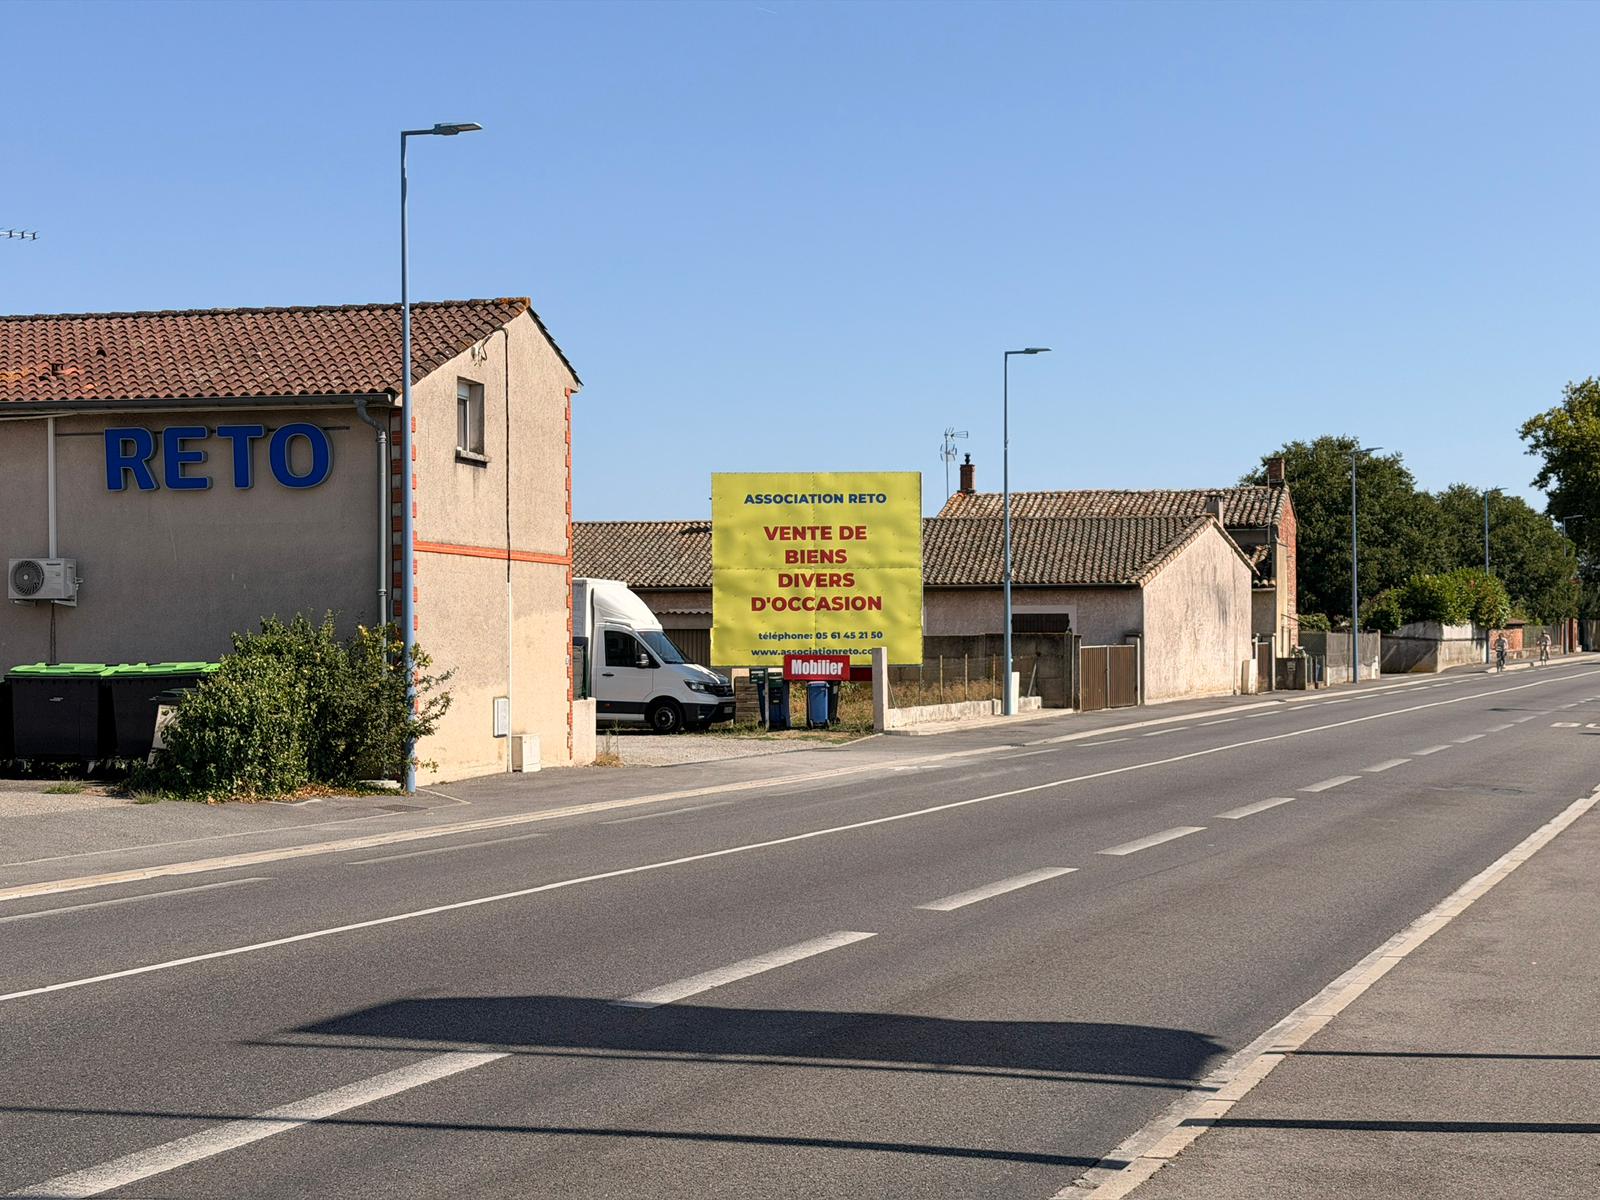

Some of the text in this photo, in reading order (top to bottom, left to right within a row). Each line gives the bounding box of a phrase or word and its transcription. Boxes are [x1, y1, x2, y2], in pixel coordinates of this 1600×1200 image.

[104, 422, 334, 492] RETO
[744, 493, 887, 504] ASSOCIATION RETO
[764, 525, 867, 541] VENTE DE
[785, 549, 848, 564] BIENS
[778, 572, 855, 588] DIVERS
[751, 596, 882, 612] D'OCCASION
[758, 631, 883, 641] téléphone: 05 61 45 21 50
[751, 647, 873, 656] www.associationreto.co
[791, 659, 844, 675] Mobilier
